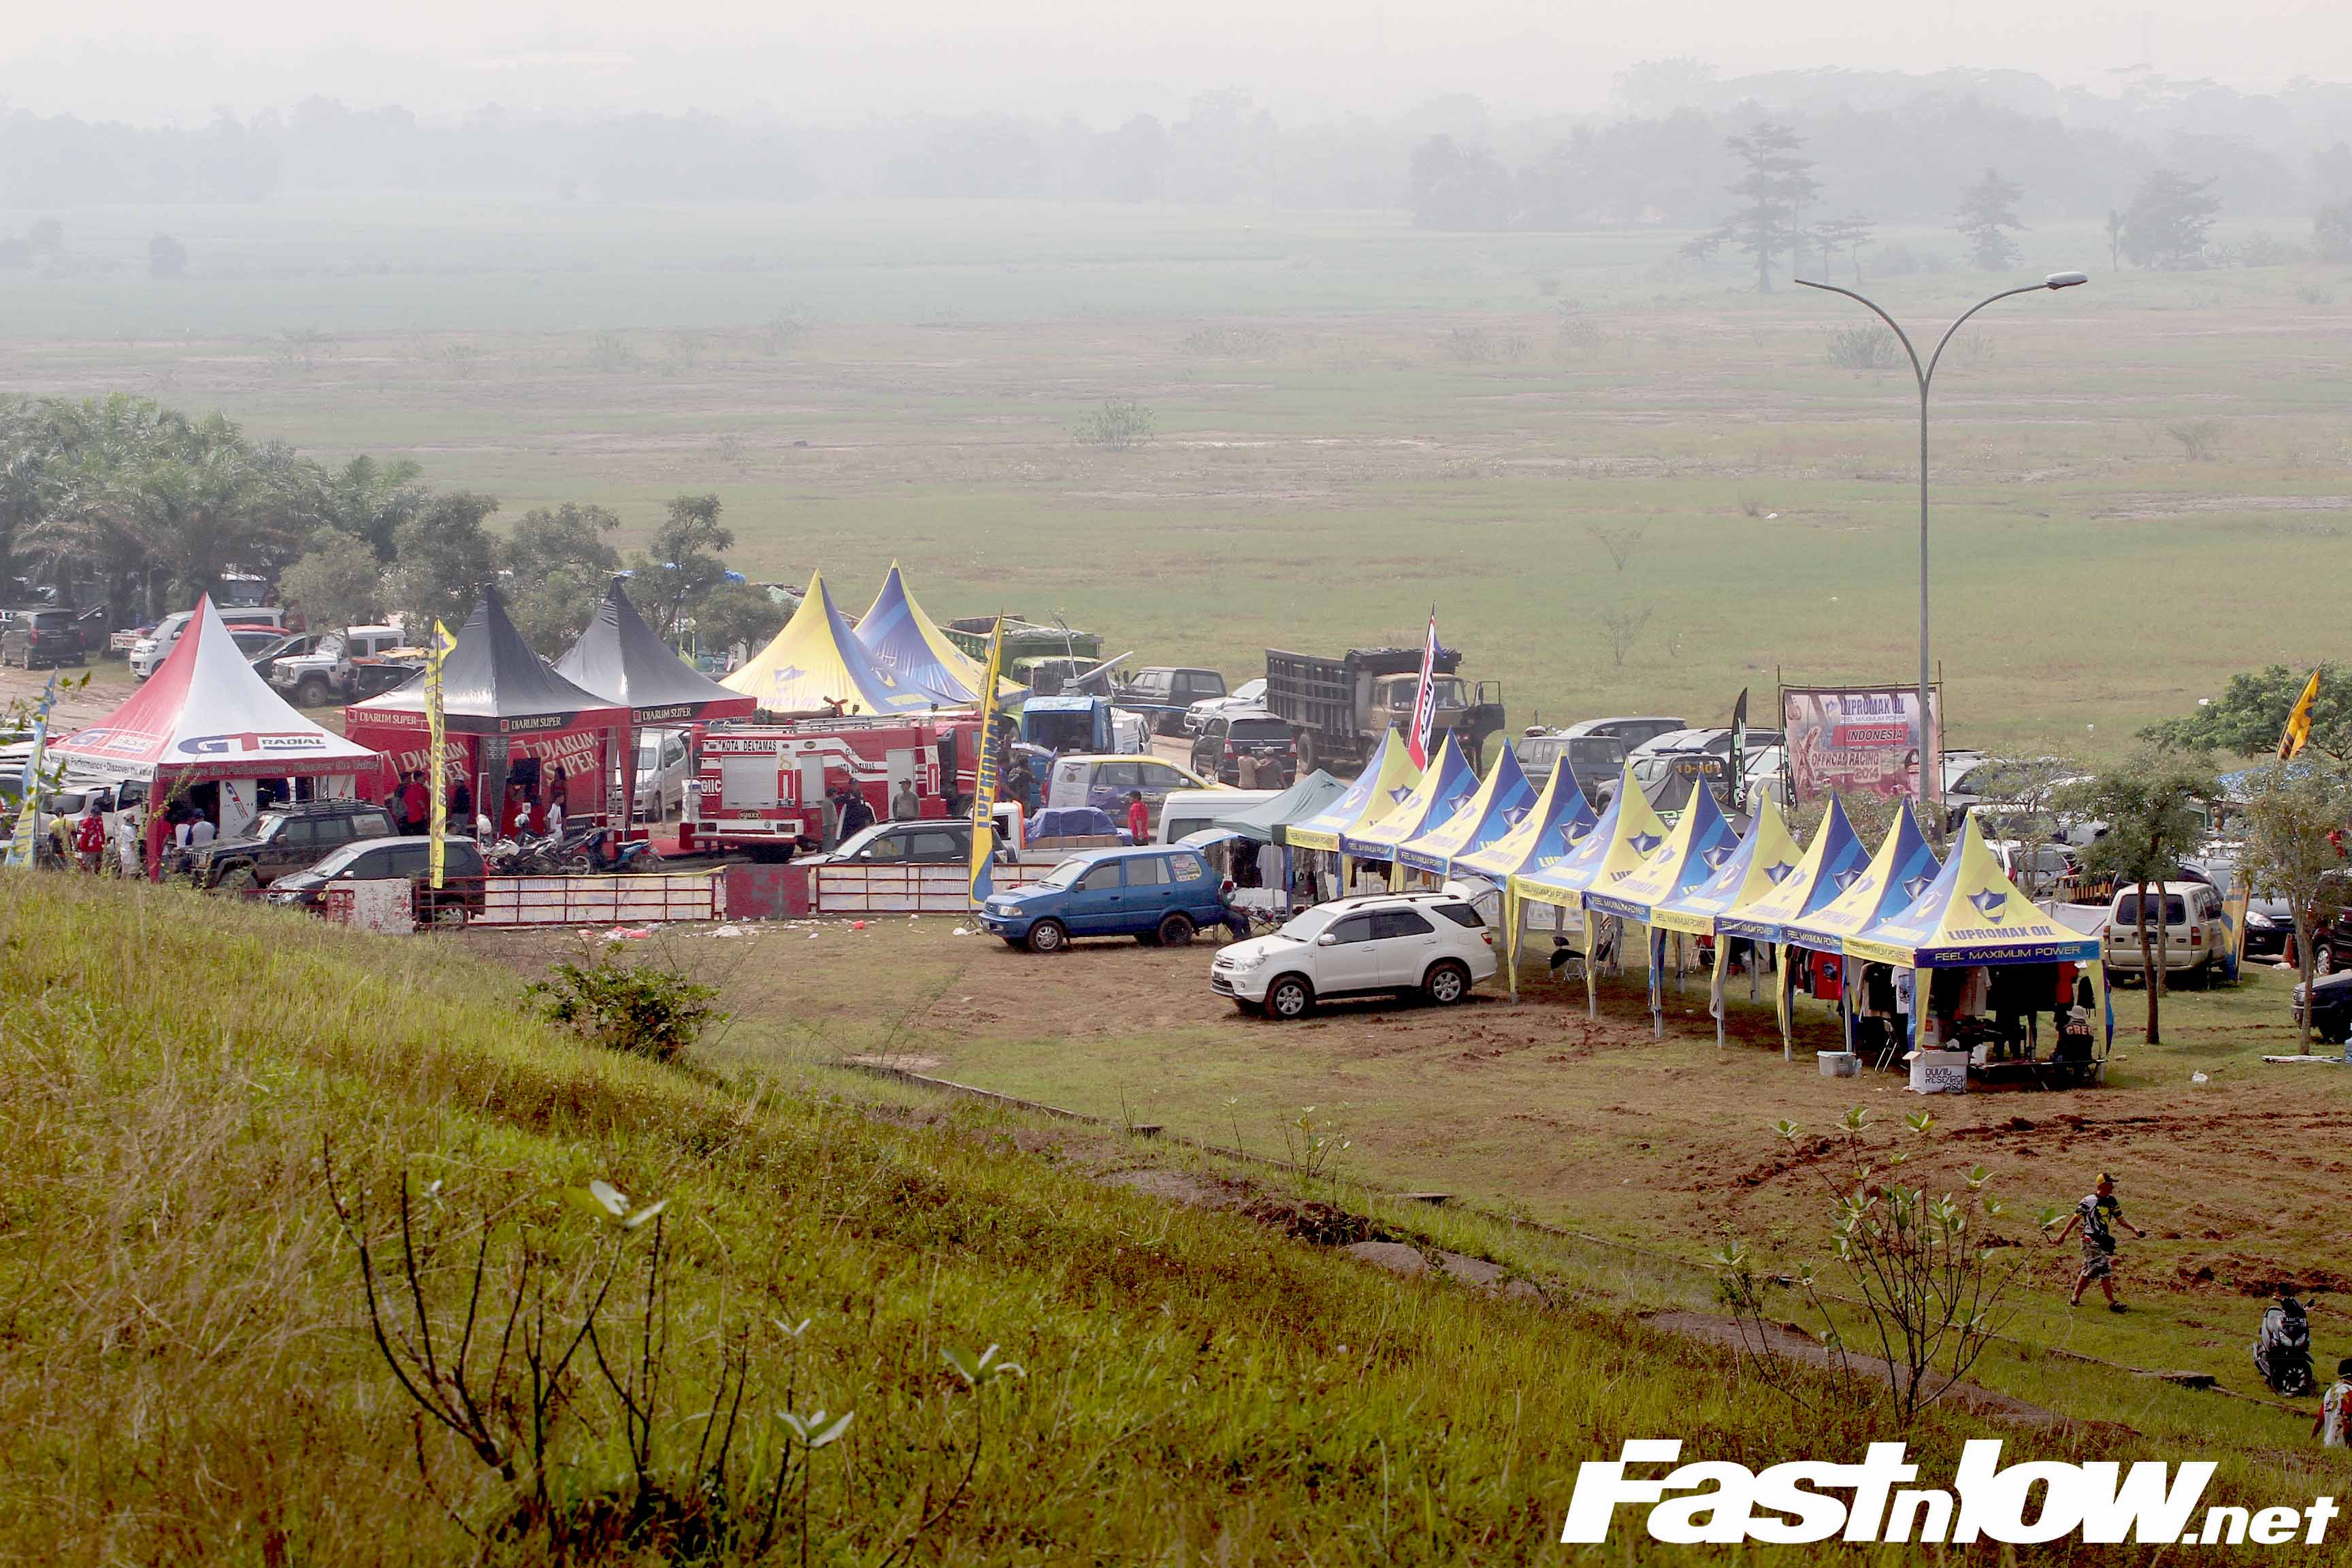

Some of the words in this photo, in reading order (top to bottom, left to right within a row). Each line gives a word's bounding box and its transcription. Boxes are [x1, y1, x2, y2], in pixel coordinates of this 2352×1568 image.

[642, 708, 670, 721] DJARUM
[670, 706, 691, 718] SUPER
[1840, 698, 1889, 715] LUPROMAX
[1891, 697, 1906, 715] OIL
[359, 712, 391, 723] DJARUM
[391, 715, 417, 725] SUPER
[511, 719, 539, 730] DJARUM
[540, 717, 561, 728] SUPER
[261, 738, 325, 746] RADIAL
[1846, 728, 1904, 742] INDONESIA
[535, 731, 598, 760] DJARUM
[721, 740, 739, 751] KOTA
[743, 740, 777, 751] DELTAMAS
[1854, 768, 1879, 779] 2014
[700, 779, 722, 794] GIIC
[1787, 930, 1799, 940] FEEL
[1799, 931, 1823, 945] MAXIMUM
[1947, 926, 2029, 941] LUPROMAX
[2031, 925, 2057, 936] OIL
[1934, 951, 1965, 962] FEEL
[1969, 948, 2031, 960] MAXIMUM
[2036, 946, 2080, 956] POWER
